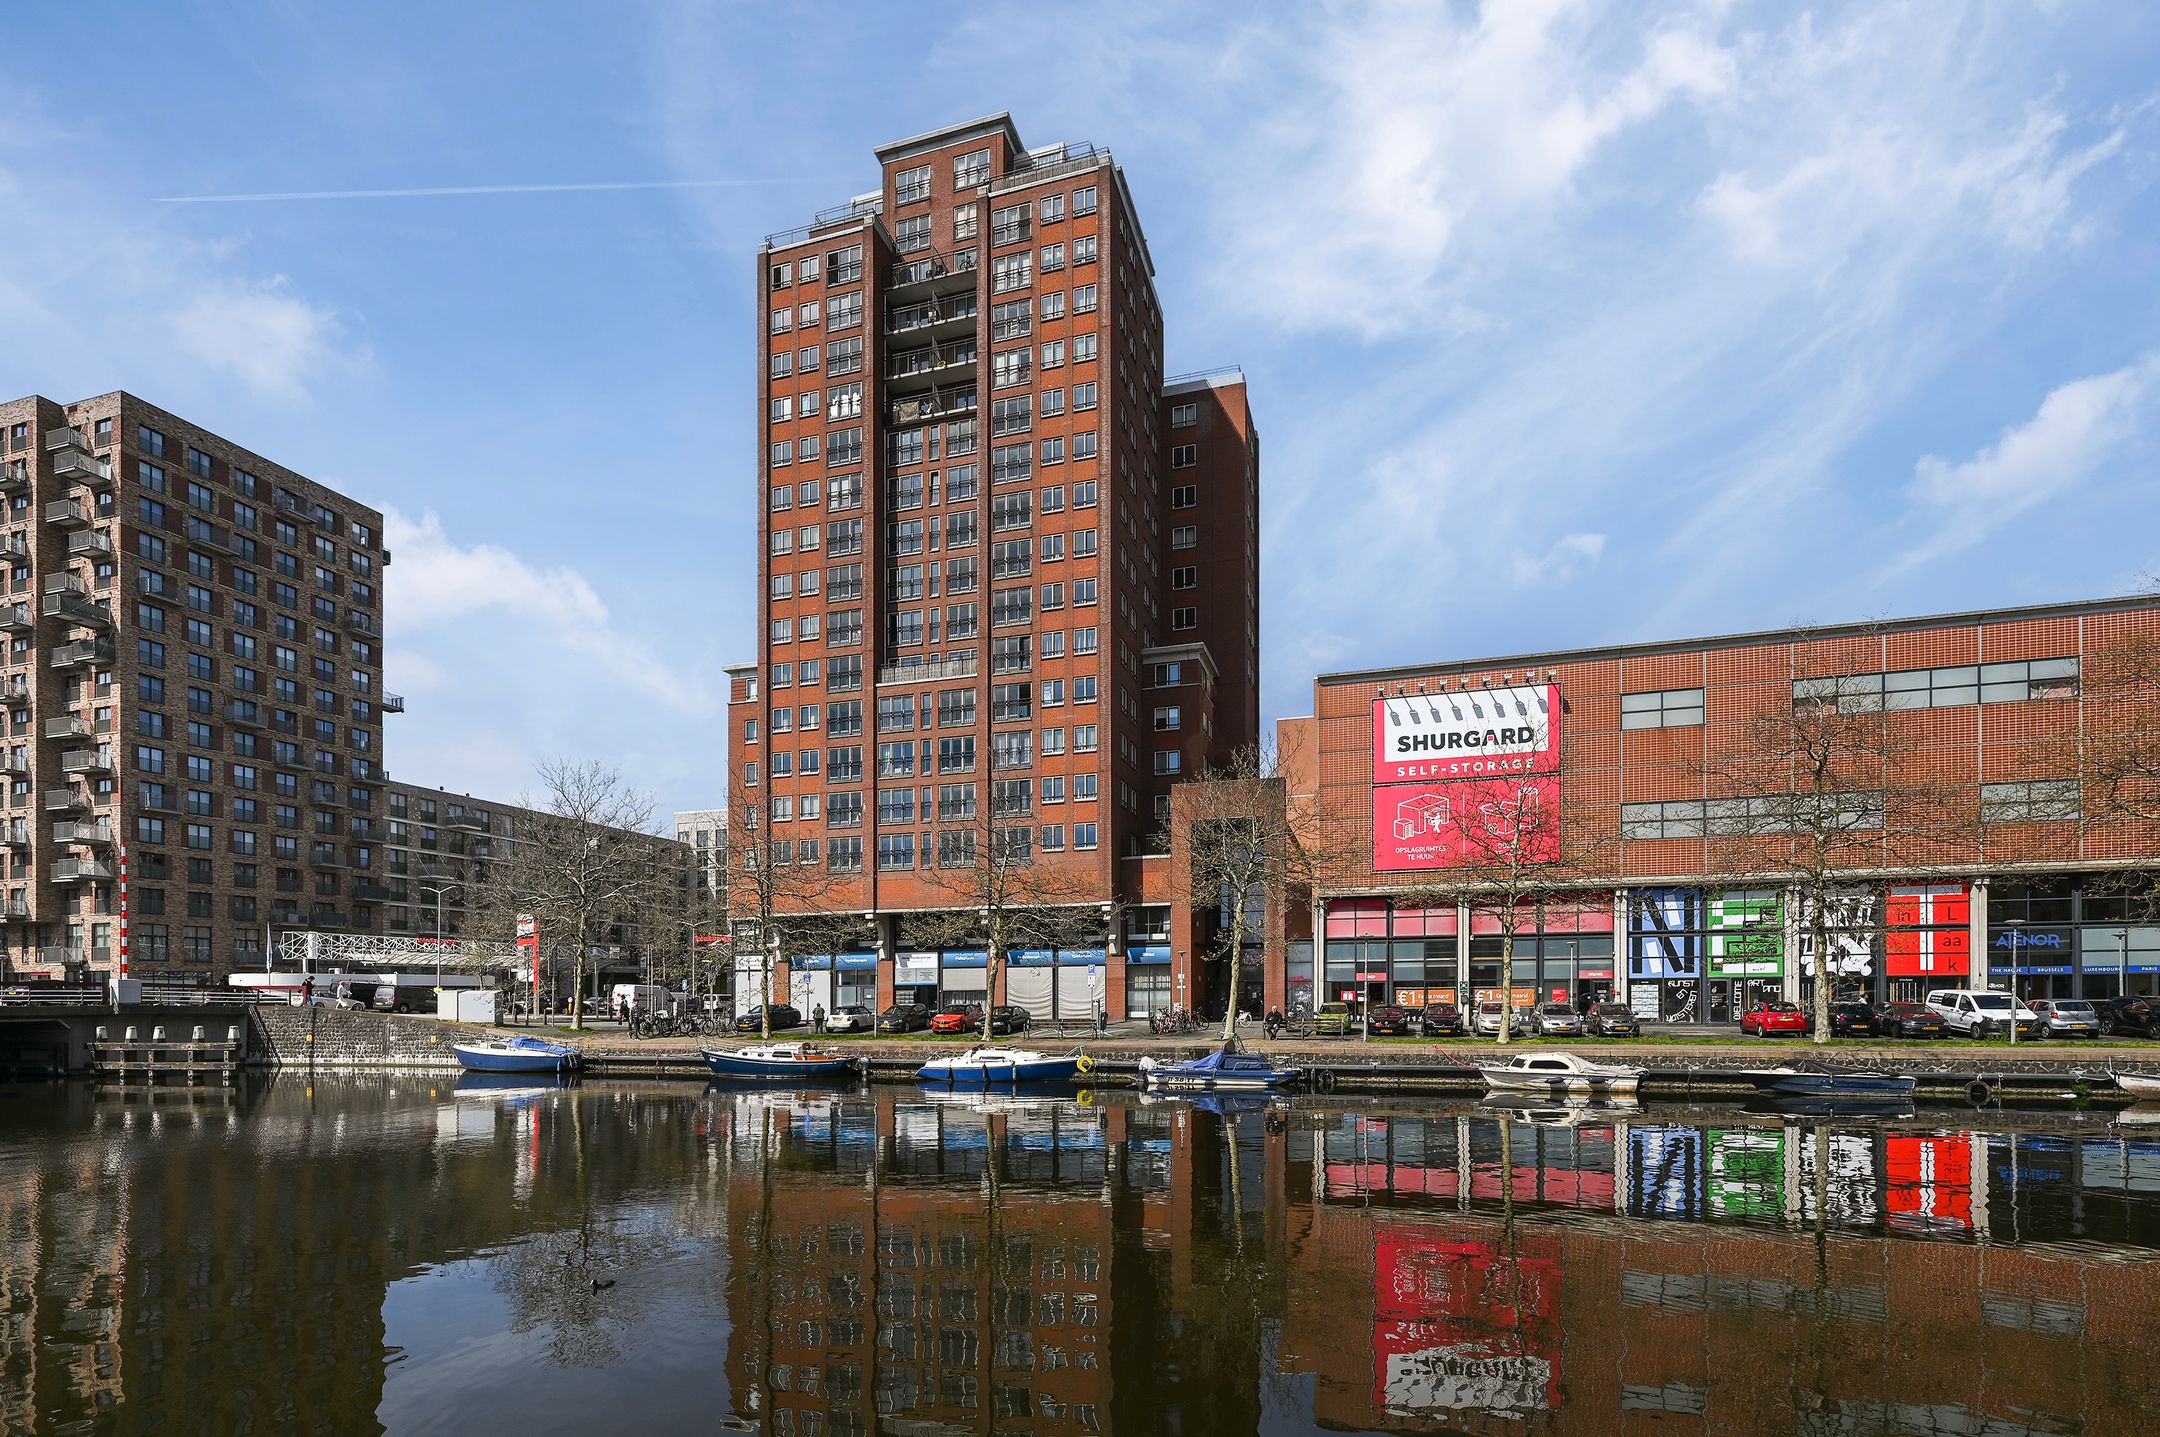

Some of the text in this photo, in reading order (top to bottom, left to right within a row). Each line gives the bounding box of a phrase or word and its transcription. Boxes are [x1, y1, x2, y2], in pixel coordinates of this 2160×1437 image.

[1397, 726, 1534, 752] SHURGARD
[1397, 758, 1534, 777] SELF-STORAGE
[1395, 845, 1447, 854] OPSLAGRUIMTES
[1398, 990, 1416, 1005] €1
[1475, 990, 1493, 1003] €1
[1733, 981, 1742, 1020] WELCOME
